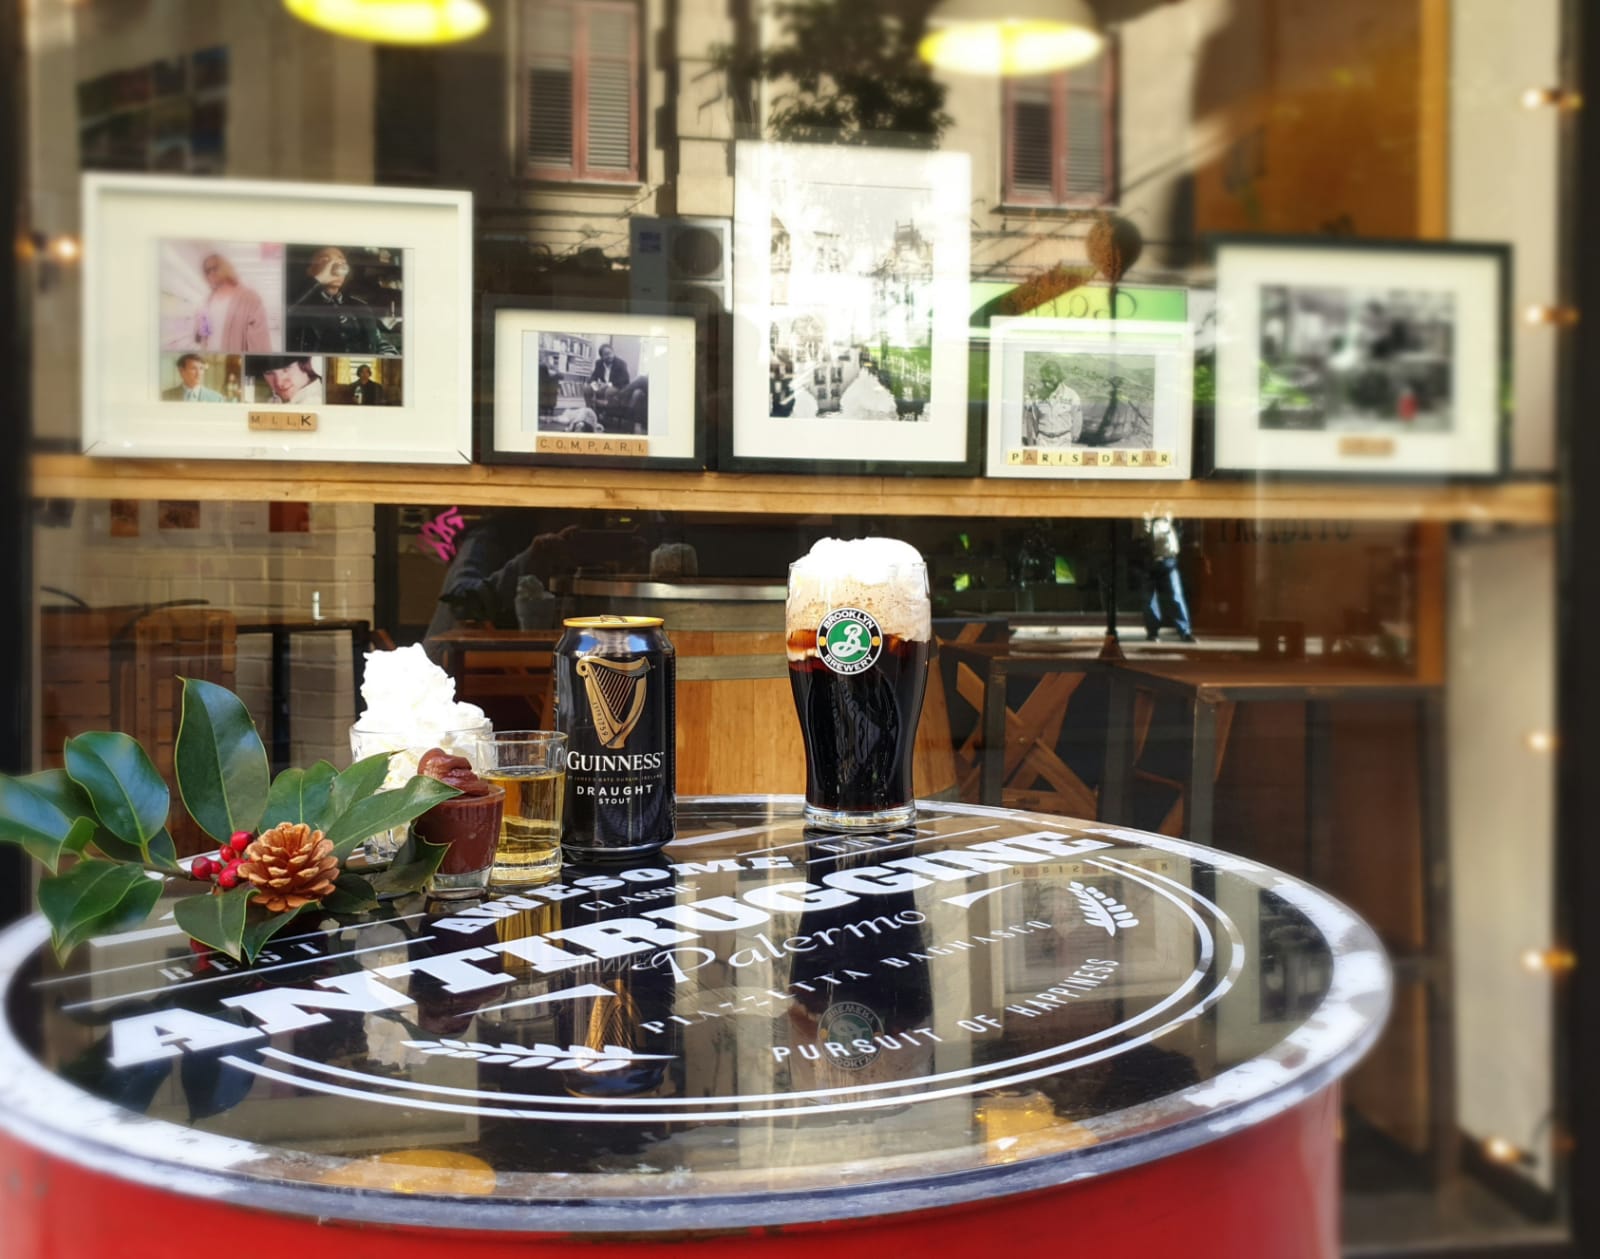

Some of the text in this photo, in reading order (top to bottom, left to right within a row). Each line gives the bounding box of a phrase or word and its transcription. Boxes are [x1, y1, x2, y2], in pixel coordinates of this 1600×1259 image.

[823, 610, 875, 629] BROOKLYN
[824, 654, 873, 671] BREWERY
[567, 751, 661, 771] GUINNESS
[577, 784, 653, 796] DRAUGHT
[598, 797, 631, 805] STOUT
[431, 856, 795, 934] AWESOME
[580, 884, 701, 911] CLASSIC
[108, 831, 1115, 1068] ANTIRUGGINE
[159, 942, 321, 981] BEST
[631, 910, 927, 984] Palermo
[638, 919, 1052, 1035] PIAZZETTA BAGNASCO
[772, 957, 1119, 1063] PURSUIT OF HAPPINESS
